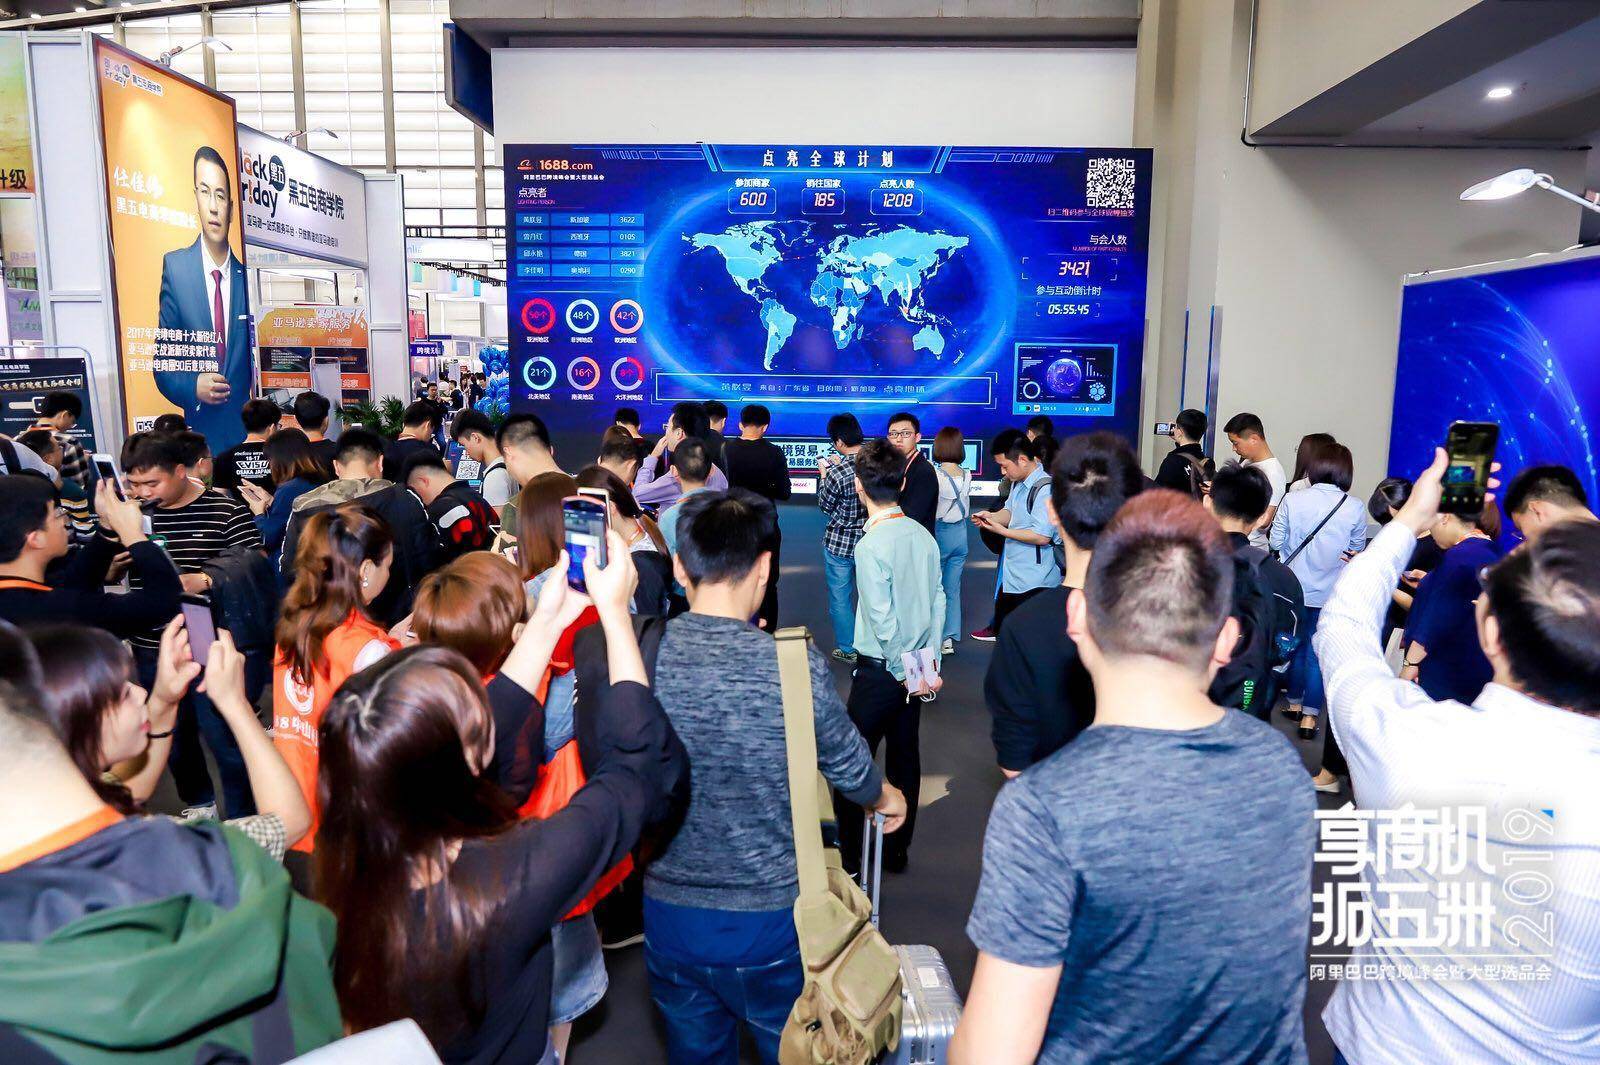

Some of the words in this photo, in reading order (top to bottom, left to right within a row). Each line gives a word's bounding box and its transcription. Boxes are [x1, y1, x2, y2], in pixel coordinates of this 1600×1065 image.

[762, 149, 894, 168] 点亮全球计划
[539, 159, 593, 171] 1688.com
[734, 178, 771, 188] 参加商家
[805, 179, 842, 188] 销往国家
[879, 179, 915, 189] 点亮人数
[518, 187, 547, 198] 点亮者
[288, 178, 345, 220] 黑五电商学院
[739, 192, 768, 206] 600
[813, 193, 836, 206] 185
[882, 193, 914, 208] 1208
[619, 216, 636, 224] 3622
[1089, 234, 1128, 246] 与会人数
[1058, 261, 1091, 277] 3421
[1036, 285, 1102, 296] 参与互动倒计时
[572, 310, 593, 320] 48个
[1047, 304, 1090, 315] 05:55:45
[617, 311, 637, 320] 42个
[127, 326, 224, 344] 2017年跨境电商十大新锐红人
[128, 341, 217, 358] 亚马逊实战派新锐卖家代表
[129, 358, 219, 373] 亚马逊电商圈90后意见领袖
[530, 368, 550, 377] 21个
[574, 369, 594, 377] 16个
